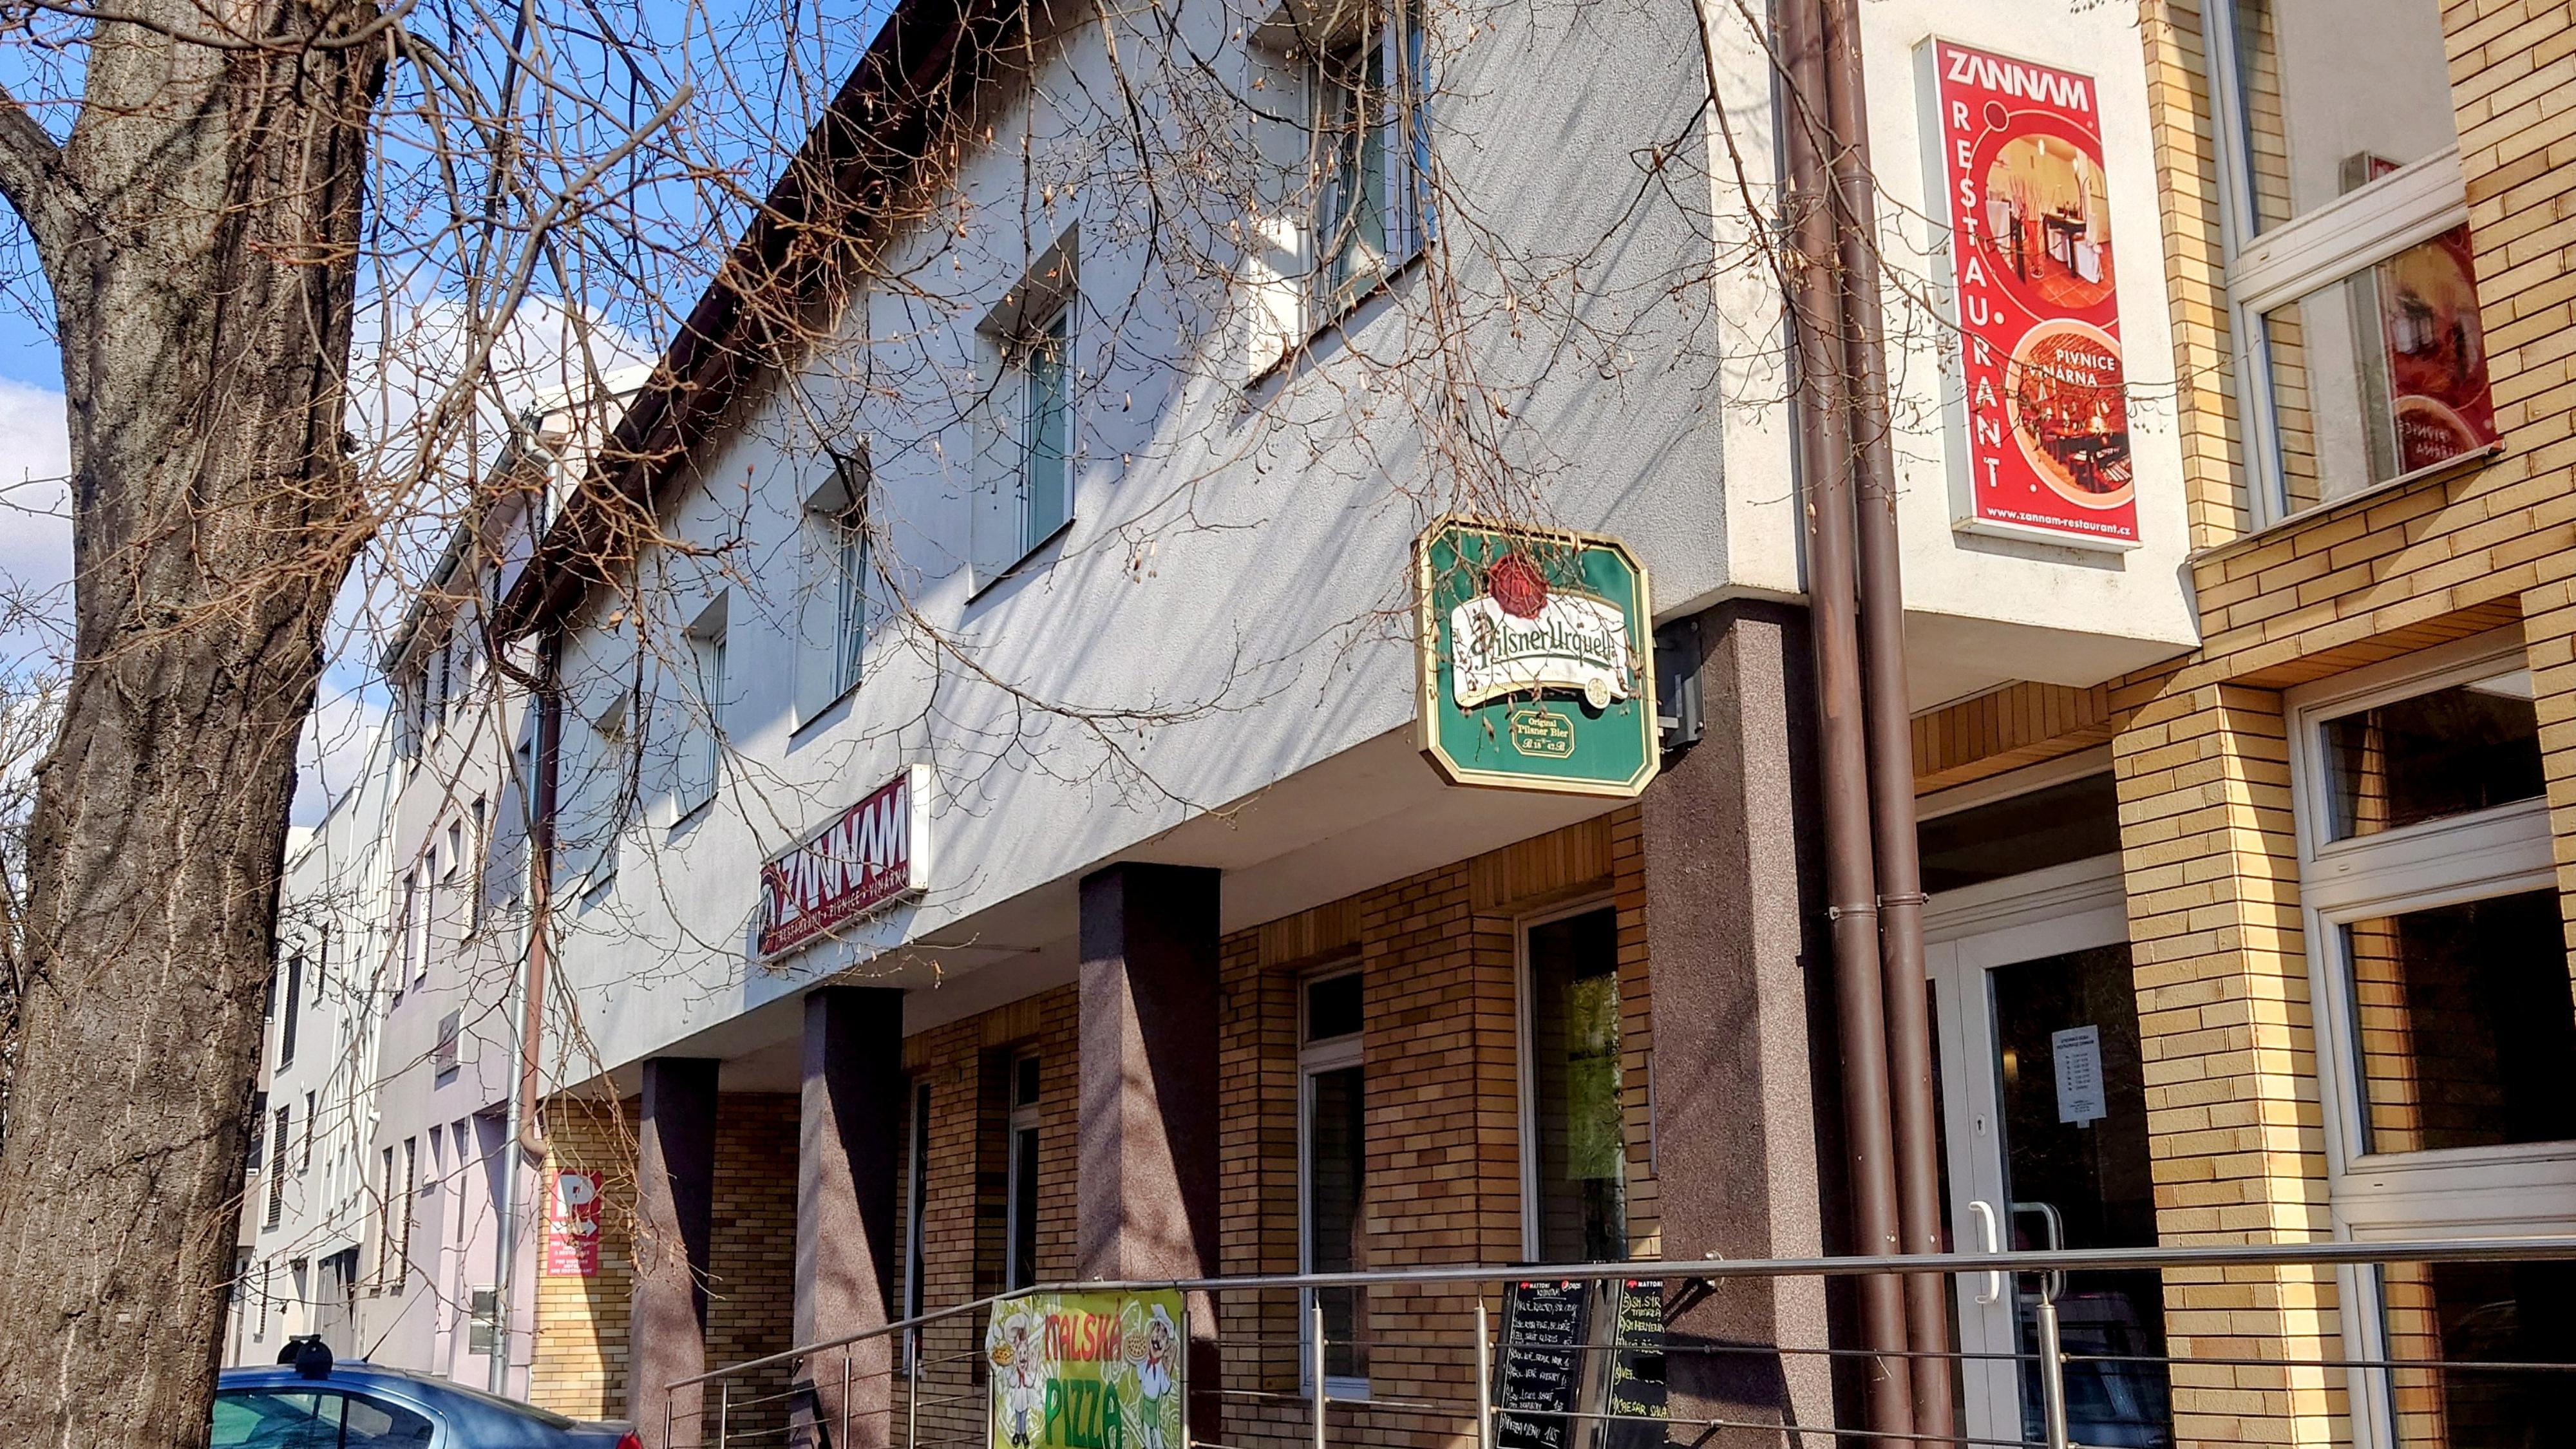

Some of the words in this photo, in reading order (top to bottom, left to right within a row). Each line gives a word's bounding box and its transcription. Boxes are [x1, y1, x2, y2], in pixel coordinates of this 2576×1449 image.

[1946, 49, 2090, 113] ZANNAM
[1953, 100, 2002, 488] RESTAURANT
[2056, 348, 2116, 372] PIVNICE
[1986, 506, 2132, 536] www.zannam-restaurant.cz
[1470, 612, 1548, 671] Pilsner
[1546, 616, 1616, 668] Urquell
[1518, 724, 1548, 735] Pilsner
[1550, 726, 1568, 737] Bier
[1528, 717, 1557, 727] Original
[780, 784, 907, 926] ZANNAM
[556, 1174, 596, 1217] P
[1045, 1298, 1122, 1362] ITALSKÁ
[1045, 1378, 1122, 1449] PIZZA
